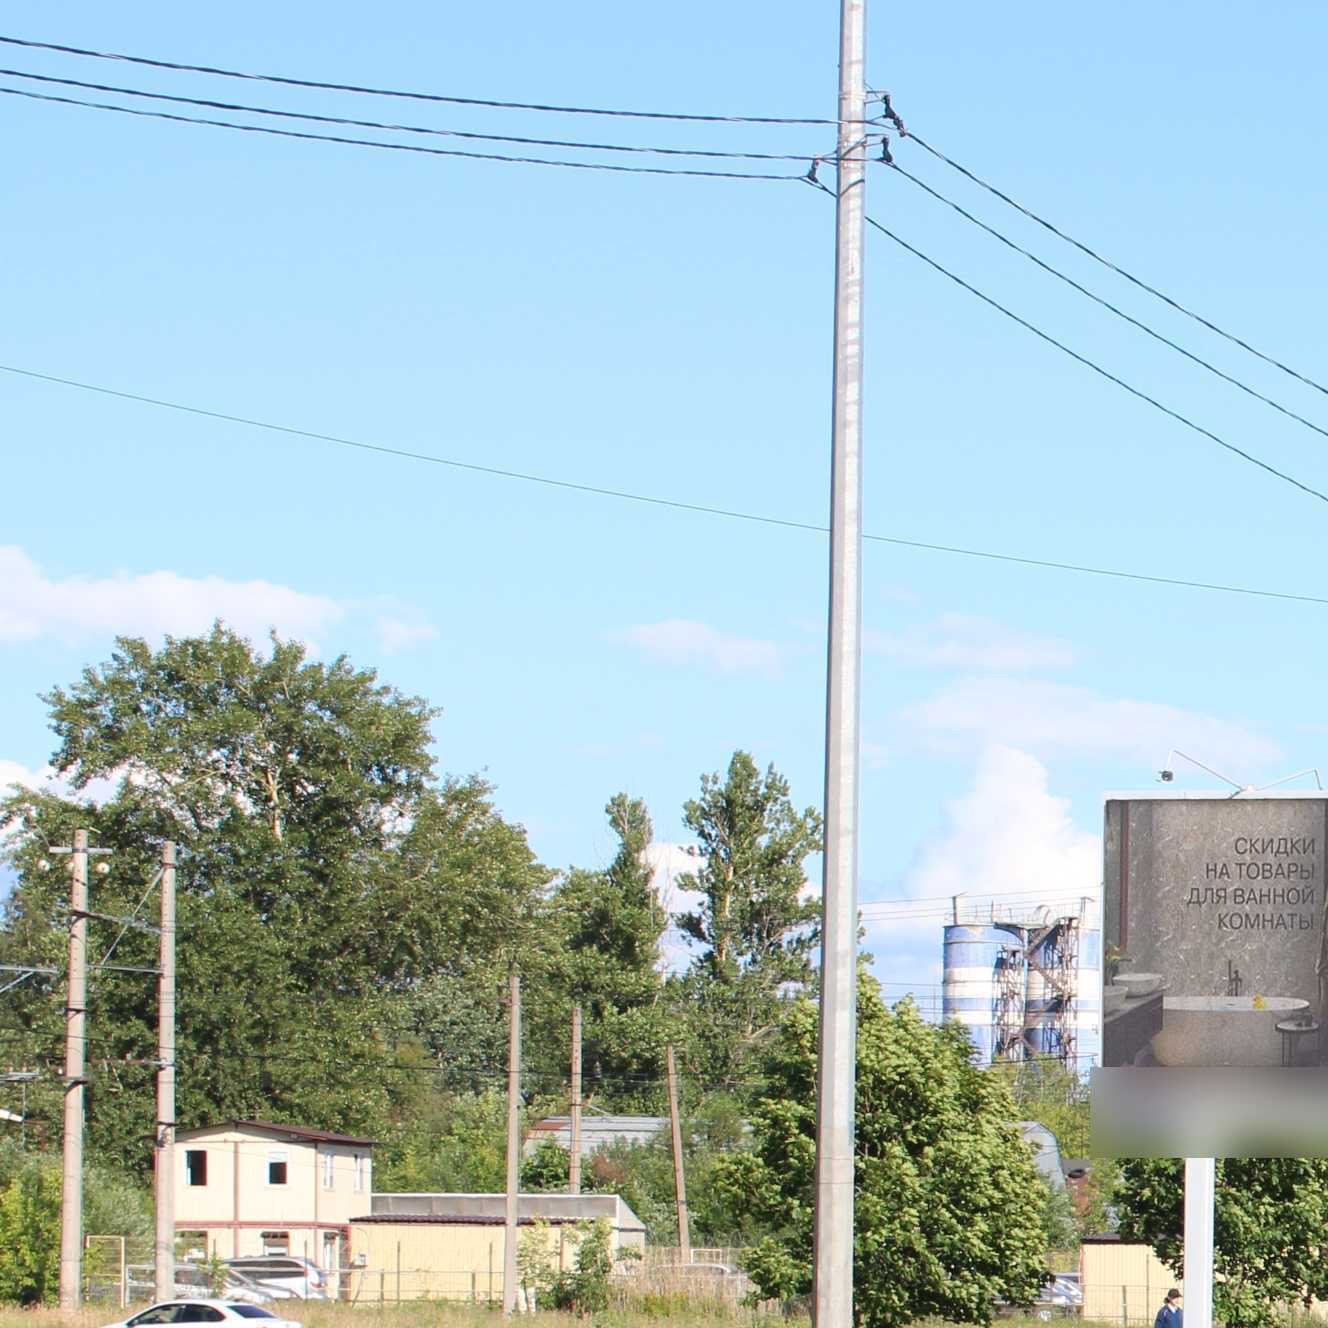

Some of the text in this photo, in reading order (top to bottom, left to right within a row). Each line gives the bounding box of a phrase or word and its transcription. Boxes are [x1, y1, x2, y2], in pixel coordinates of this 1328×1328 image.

[1234, 837, 1315, 857] СКИДКИ
[1206, 862, 1314, 880] НА ТОВАРЫ
[1186, 884, 1314, 907] ДЛЯ ВАННОЙ
[1218, 912, 1314, 930] КОМНАТЫ
